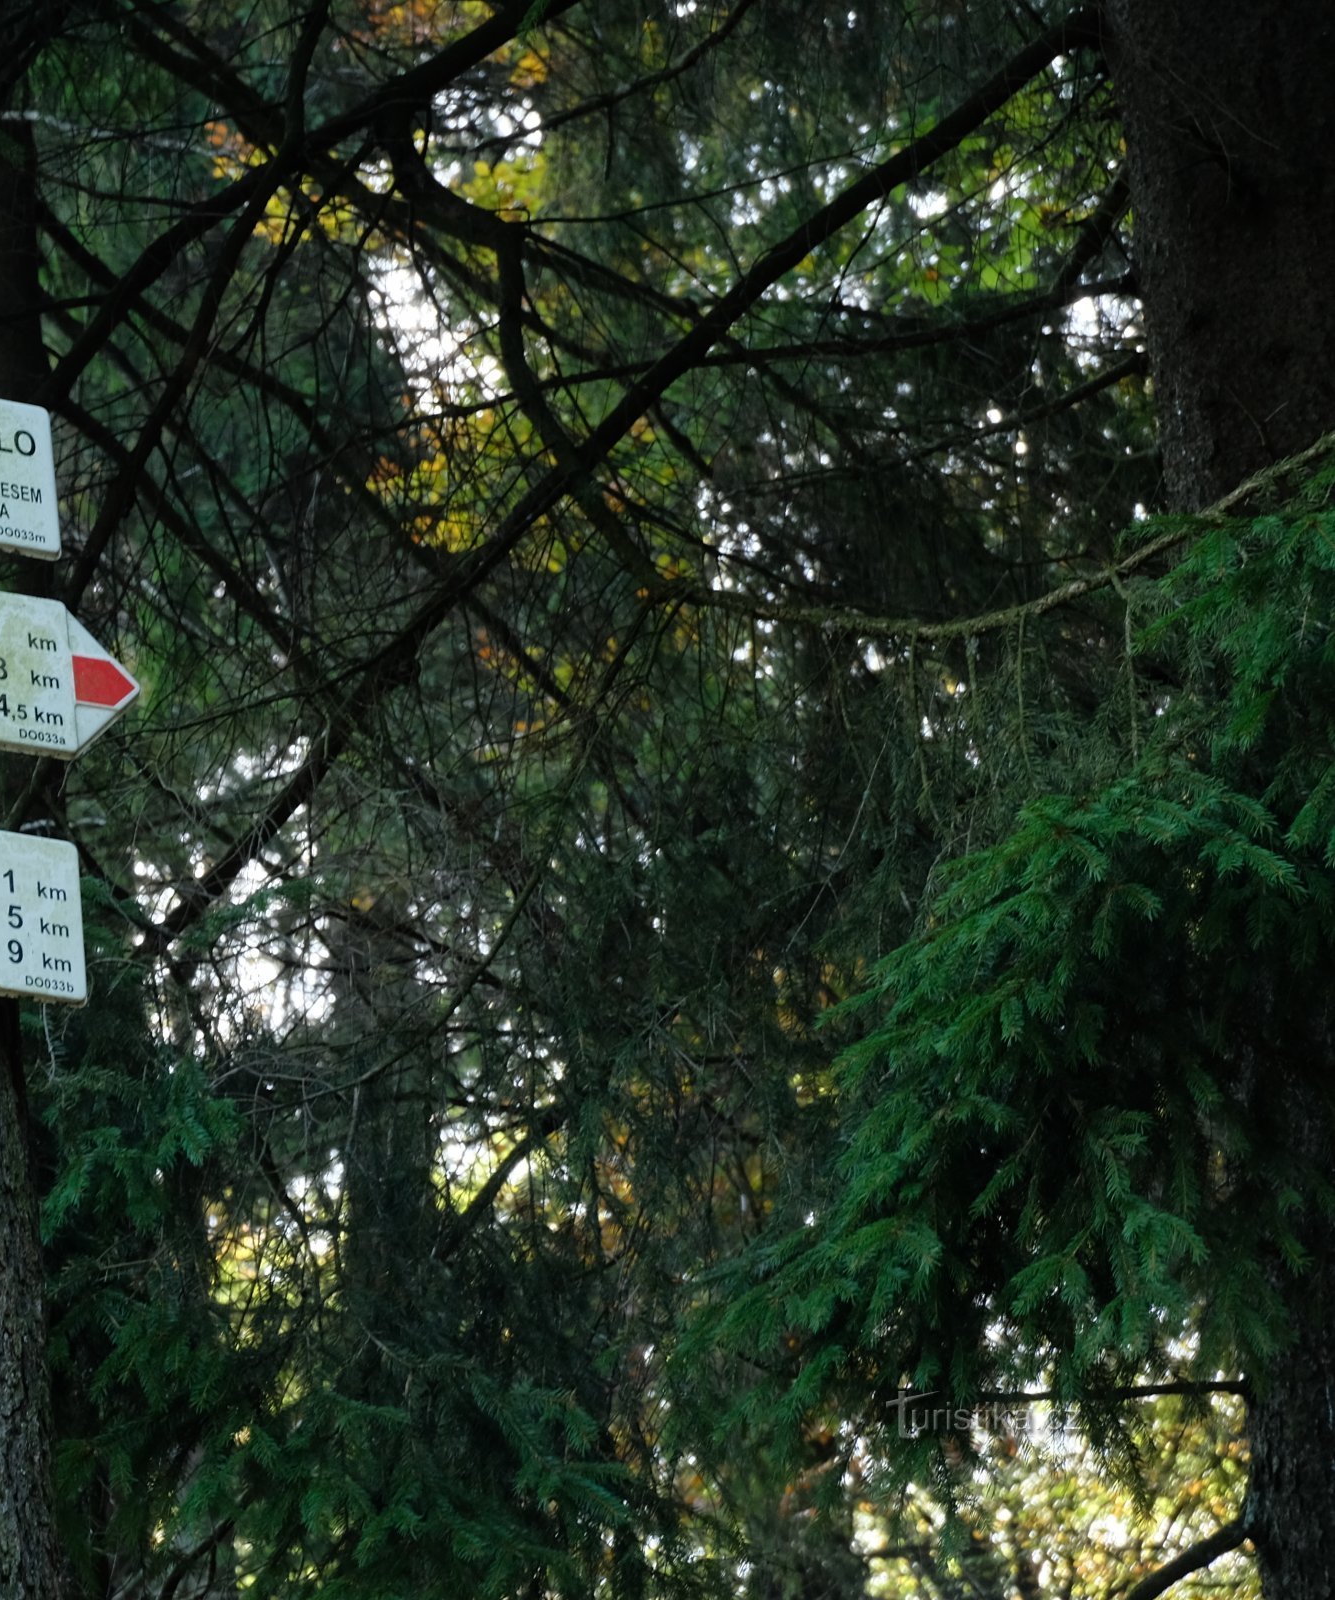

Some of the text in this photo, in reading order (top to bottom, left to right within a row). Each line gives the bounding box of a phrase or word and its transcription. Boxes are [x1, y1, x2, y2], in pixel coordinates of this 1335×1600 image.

[27, 632, 57, 652] km
[30, 670, 60, 689] km
[34, 706, 64, 726] km
[19, 728, 66, 746] DO033a
[3, 869, 15, 893] 1
[37, 881, 67, 901] km
[8, 905, 23, 929] 5
[40, 918, 69, 938] km
[7, 939, 23, 964] 9
[42, 952, 72, 973] km
[25, 975, 74, 993] DO033b
